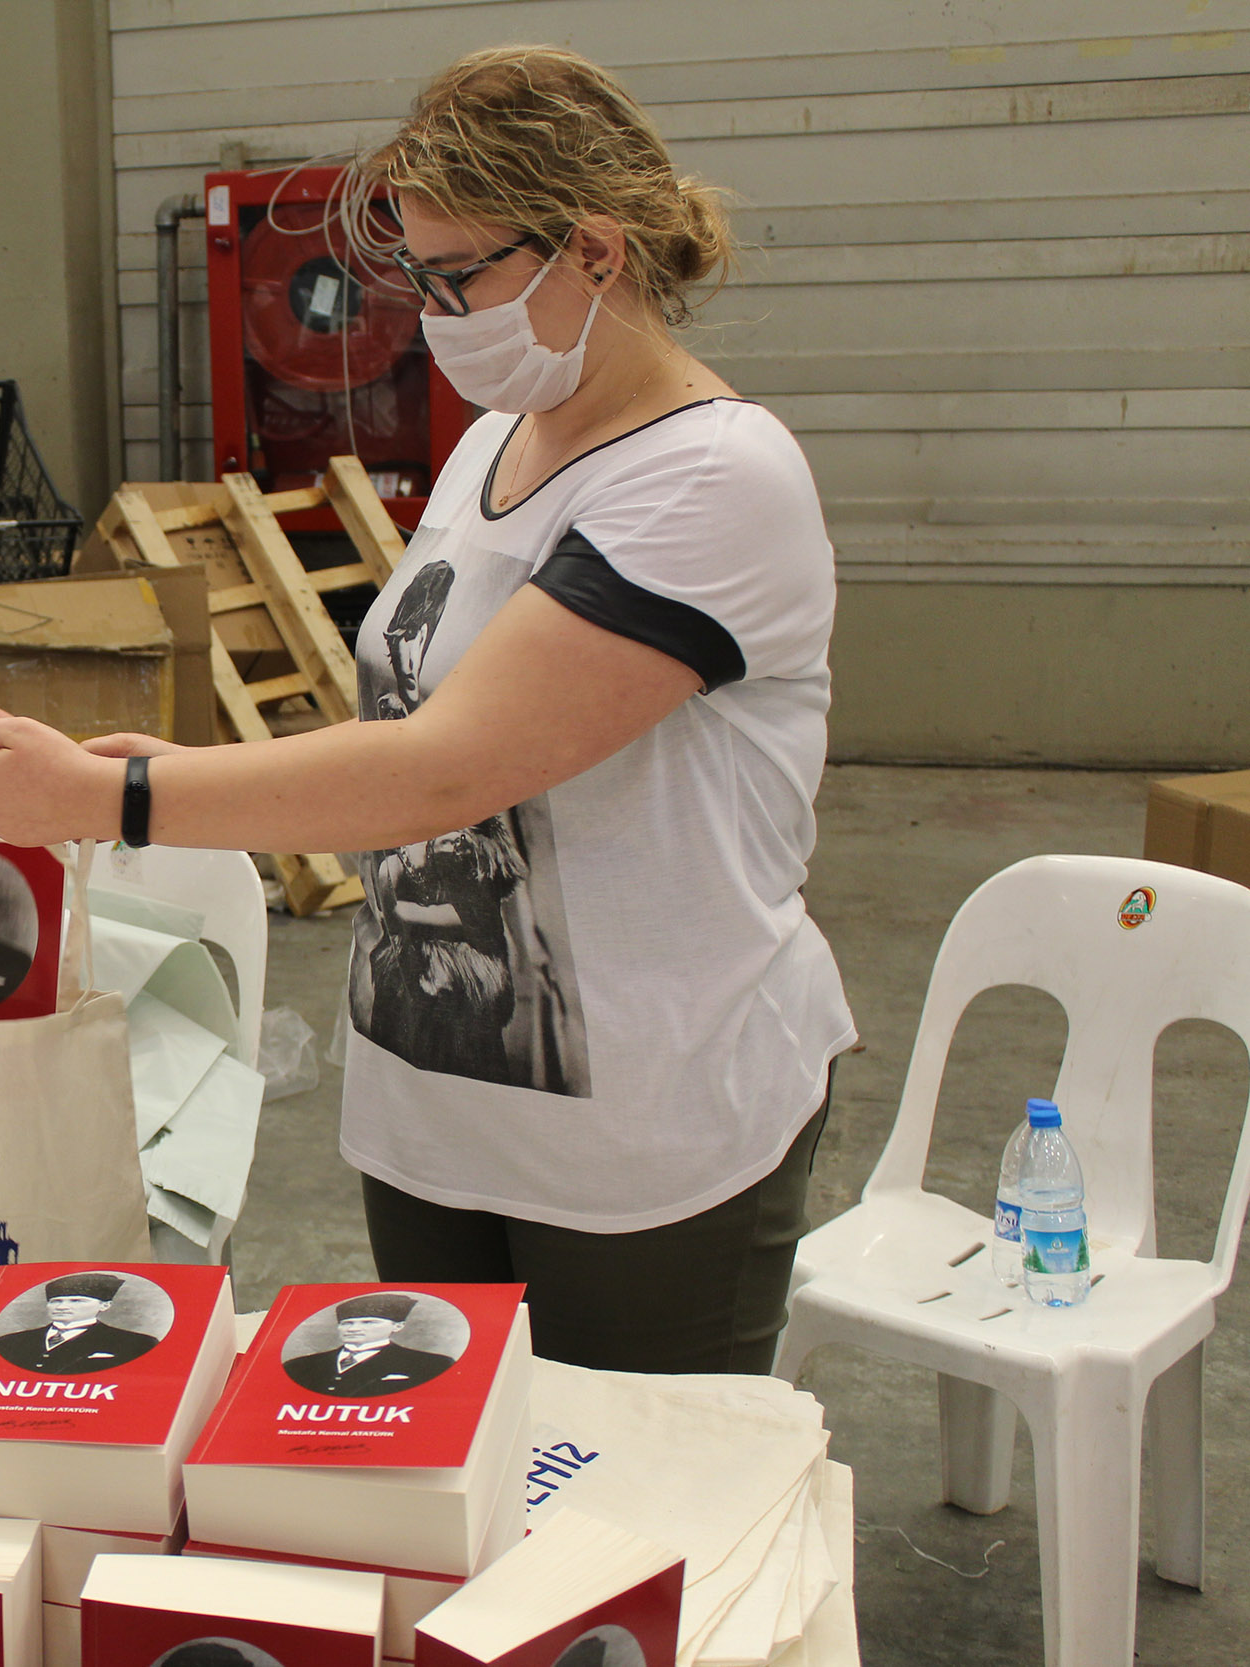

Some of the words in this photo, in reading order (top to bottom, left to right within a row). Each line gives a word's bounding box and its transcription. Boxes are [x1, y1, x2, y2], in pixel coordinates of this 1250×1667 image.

[25, 1404, 56, 1413] Kemal
[55, 1405, 100, 1414] ATATÜRK
[276, 1403, 415, 1424] NUTUK
[277, 1428, 317, 1436] Mustafa
[317, 1429, 350, 1437] Kemal
[349, 1430, 395, 1438] ATATÜRK
